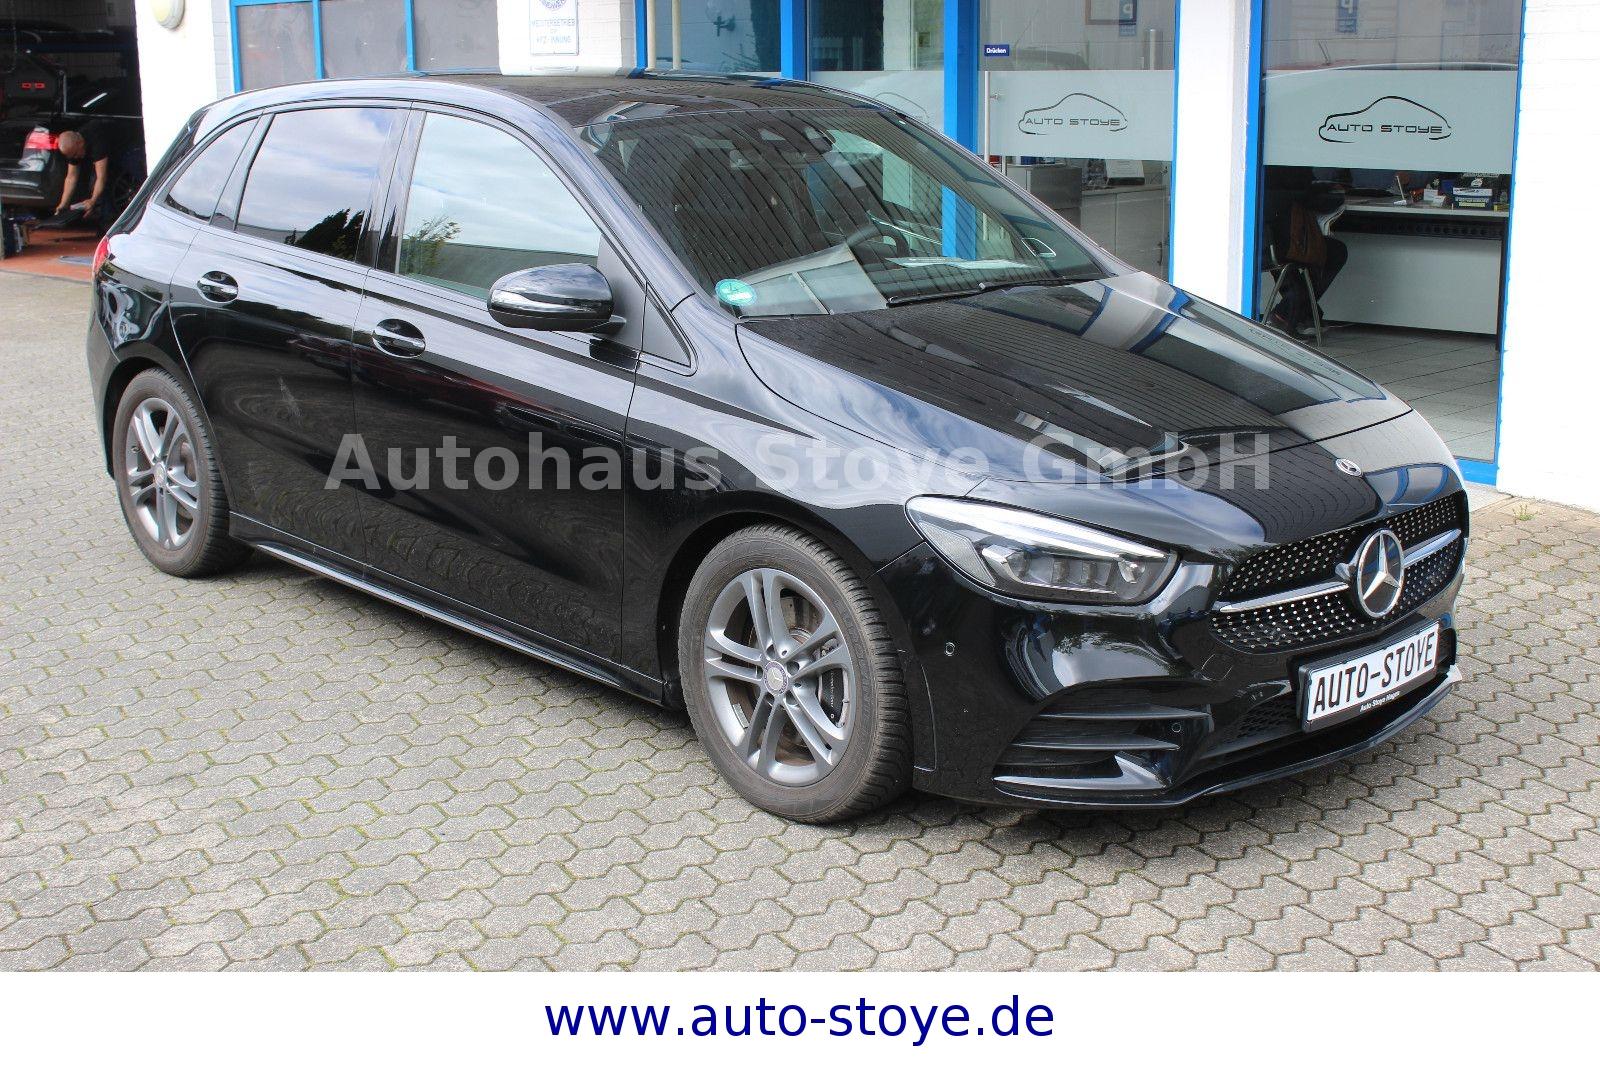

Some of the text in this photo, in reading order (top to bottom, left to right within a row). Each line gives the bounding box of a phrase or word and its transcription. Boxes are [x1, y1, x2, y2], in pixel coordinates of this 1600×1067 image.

[1025, 118, 1121, 126] AUTO STOYE
[1327, 123, 1443, 134] AUTO STOYE
[1313, 631, 1435, 714] AUTO-STOYE
